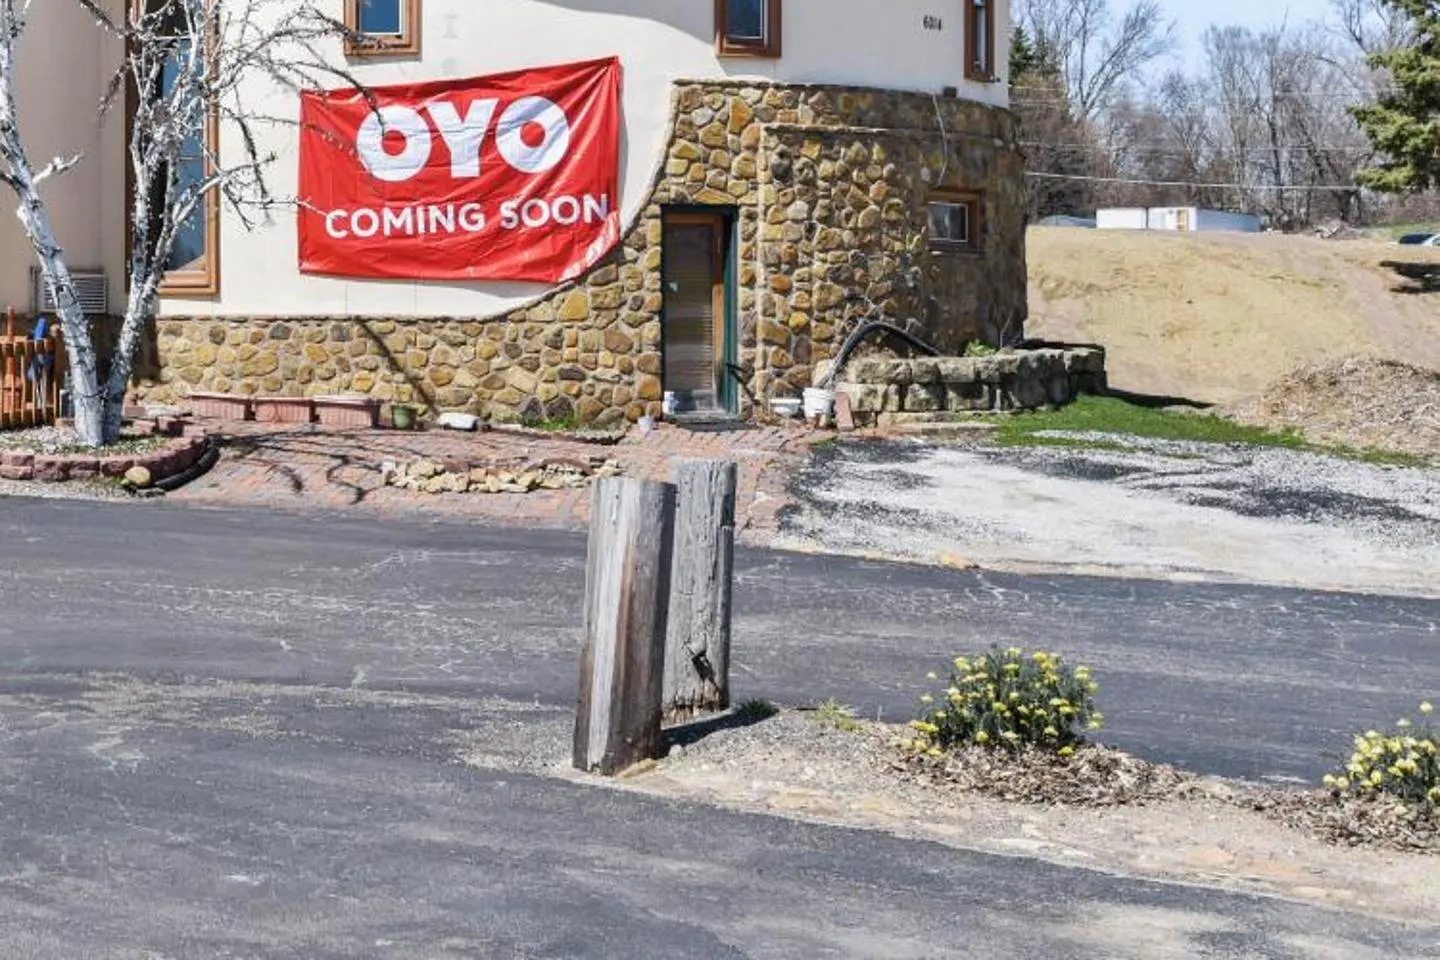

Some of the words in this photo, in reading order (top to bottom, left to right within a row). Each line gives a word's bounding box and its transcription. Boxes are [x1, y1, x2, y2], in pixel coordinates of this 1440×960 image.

[357, 96, 570, 182] OYO
[325, 203, 485, 238] COMING
[500, 194, 608, 229] SOON
